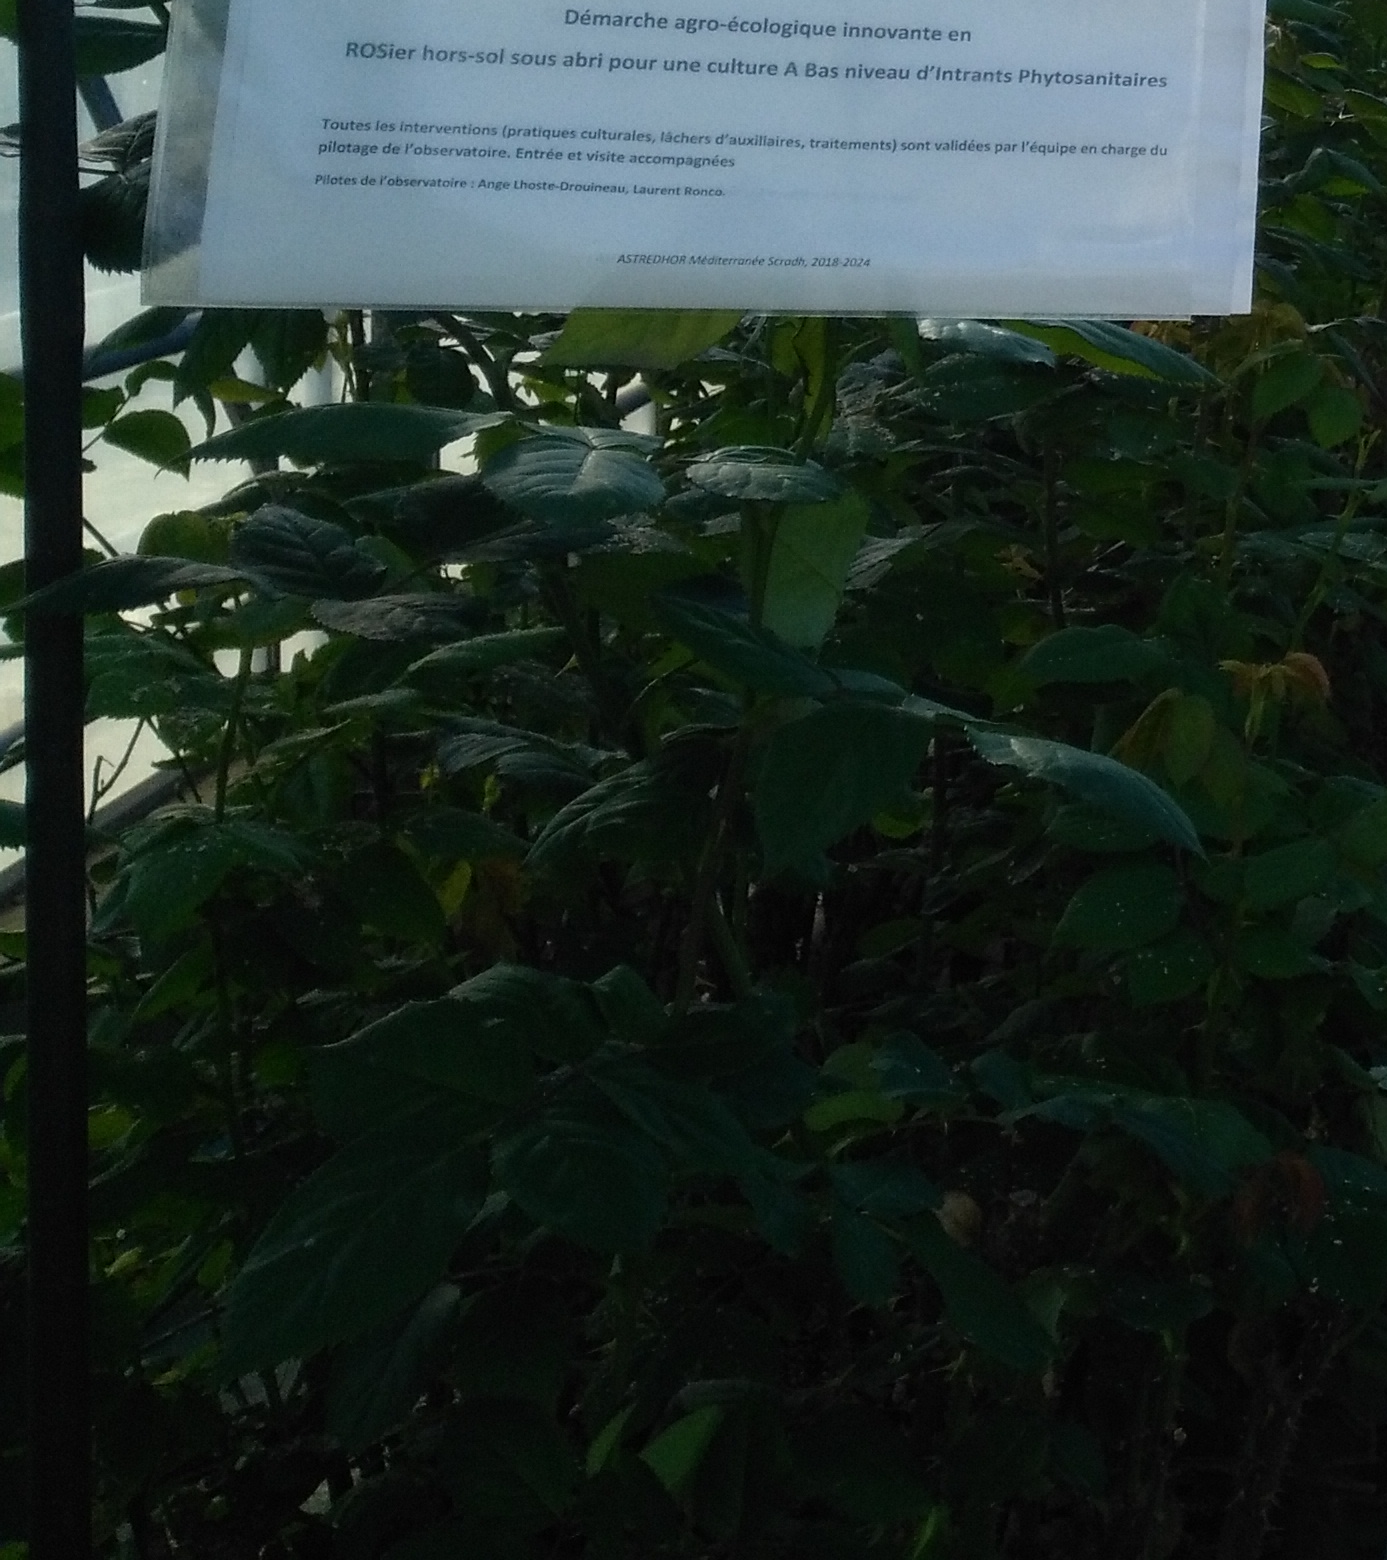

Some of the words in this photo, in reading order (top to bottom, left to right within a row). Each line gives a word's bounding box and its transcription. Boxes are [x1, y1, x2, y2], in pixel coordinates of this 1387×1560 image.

[564, 9, 668, 29] Démarche
[675, 18, 836, 38] agro-écologique
[843, 22, 942, 41] innovante
[947, 28, 971, 42] en
[345, 42, 416, 60] ROSier
[423, 45, 504, 64] hors-sol
[511, 52, 556, 67] sous
[563, 51, 603, 68] abri
[608, 55, 658, 72] pour
[663, 58, 701, 72] une
[707, 58, 777, 76] culture
[783, 61, 798, 77] A
[805, 62, 838, 78] Bas
[845, 63, 910, 80] niveau
[917, 65, 1012, 83] d'Intrants
[1018, 70, 1168, 88] Phytosanitaires
[322, 119, 371, 131] Toutes
[375, 120, 395, 131] les
[400, 121, 498, 136] interventions
[502, 125, 576, 140] (pratiques
[581, 129, 657, 144] culturales,
[660, 132, 711, 145] lâchers
[715, 134, 805, 149] d'auxiliaires,
[809, 138, 897, 152] traitements)
[901, 141, 931, 151] sont
[935, 140, 991, 152] validées
[994, 143, 1017, 154] par
[1022, 142, 1076, 156] l'équipe
[1080, 145, 1097, 155] en
[1101, 144, 1147, 157] charge
[1150, 145, 1167, 156] du
[318, 141, 378, 156] pilotage
[382, 143, 400, 155] de
[405, 144, 511, 159] l'observatoire.
[516, 148, 563, 160] Entrée
[567, 151, 582, 161] et
[587, 151, 625, 163] visite
[629, 153, 735, 168] accompagnées
[314, 175, 357, 185] Pilotes
[360, 176, 376, 186] de
[380, 178, 467, 188] l'observatoire
[477, 179, 510, 190] Ange
[633, 185, 681, 195] Laurent
[617, 254, 686, 265] ASTREDHOR
[812, 257, 870, 267] 2018-2024
